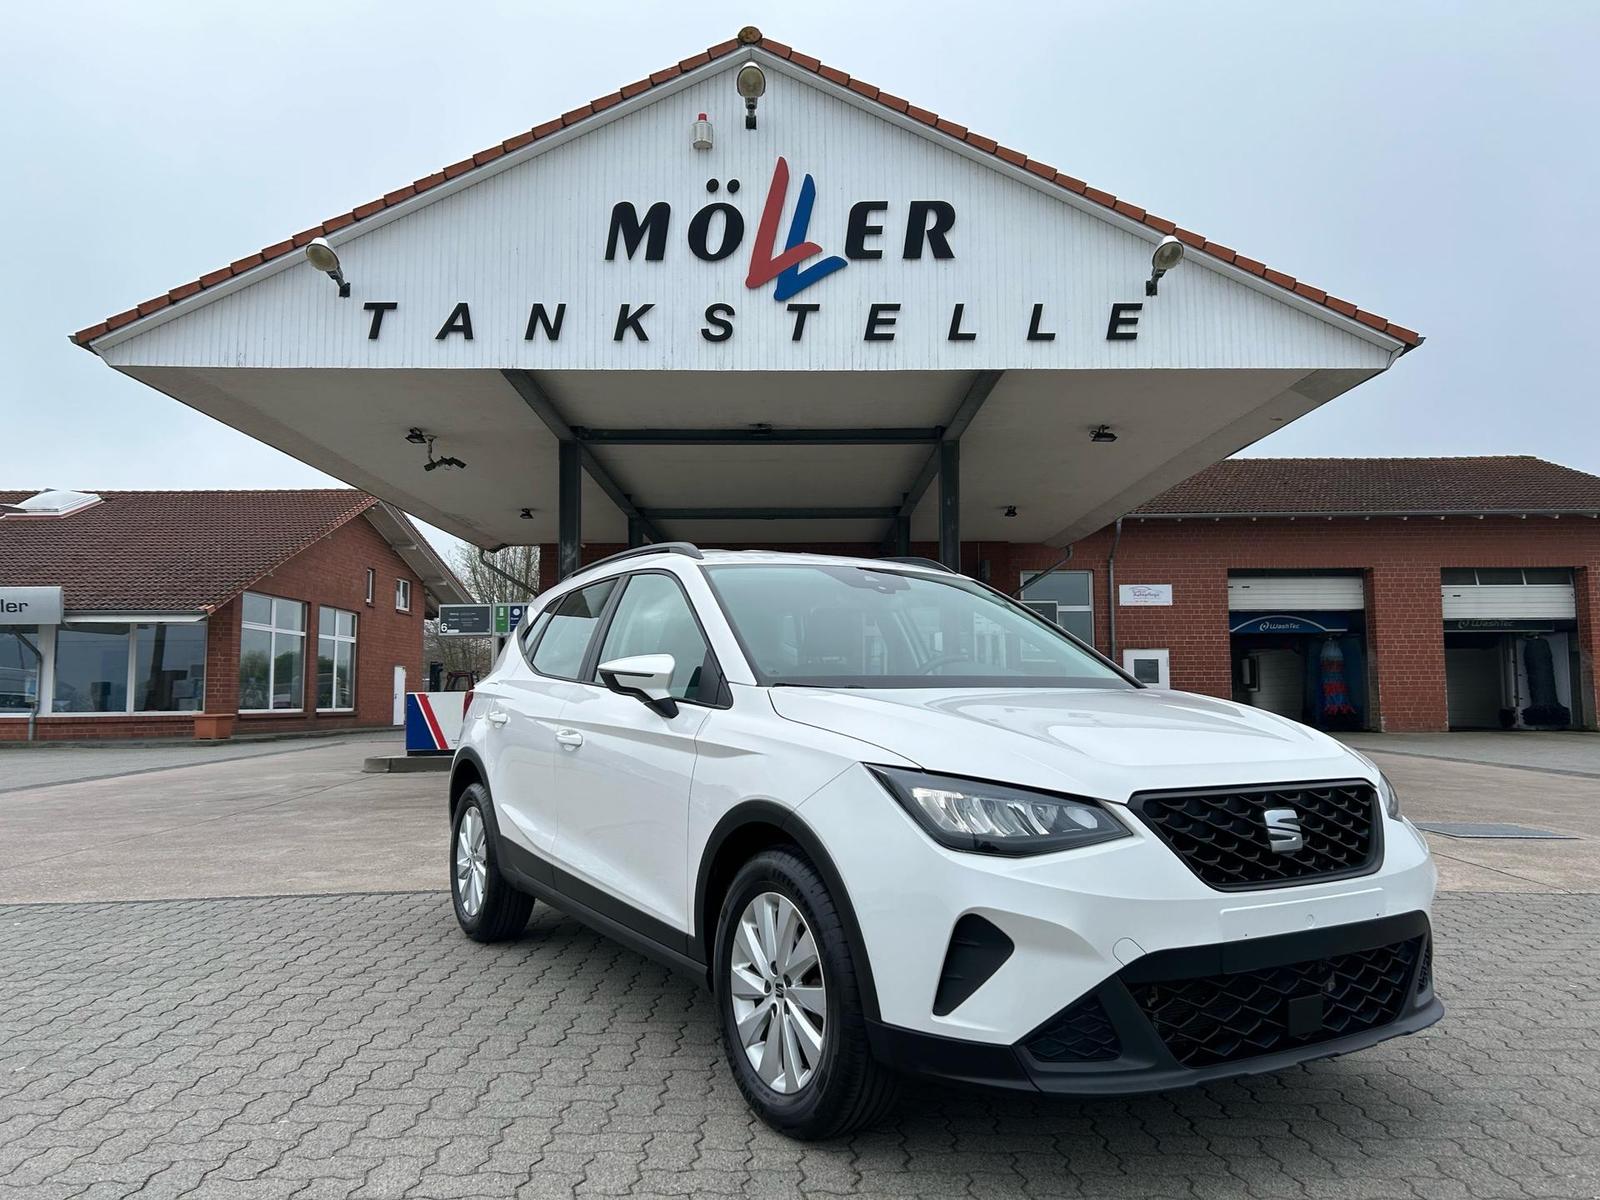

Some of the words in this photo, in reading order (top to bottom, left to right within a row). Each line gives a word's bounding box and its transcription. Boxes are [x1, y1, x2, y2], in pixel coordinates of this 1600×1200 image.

[605, 156, 956, 301] MÖLLER
[363, 302, 1143, 342] TANKSTELLE
[440, 622, 448, 632] 6
